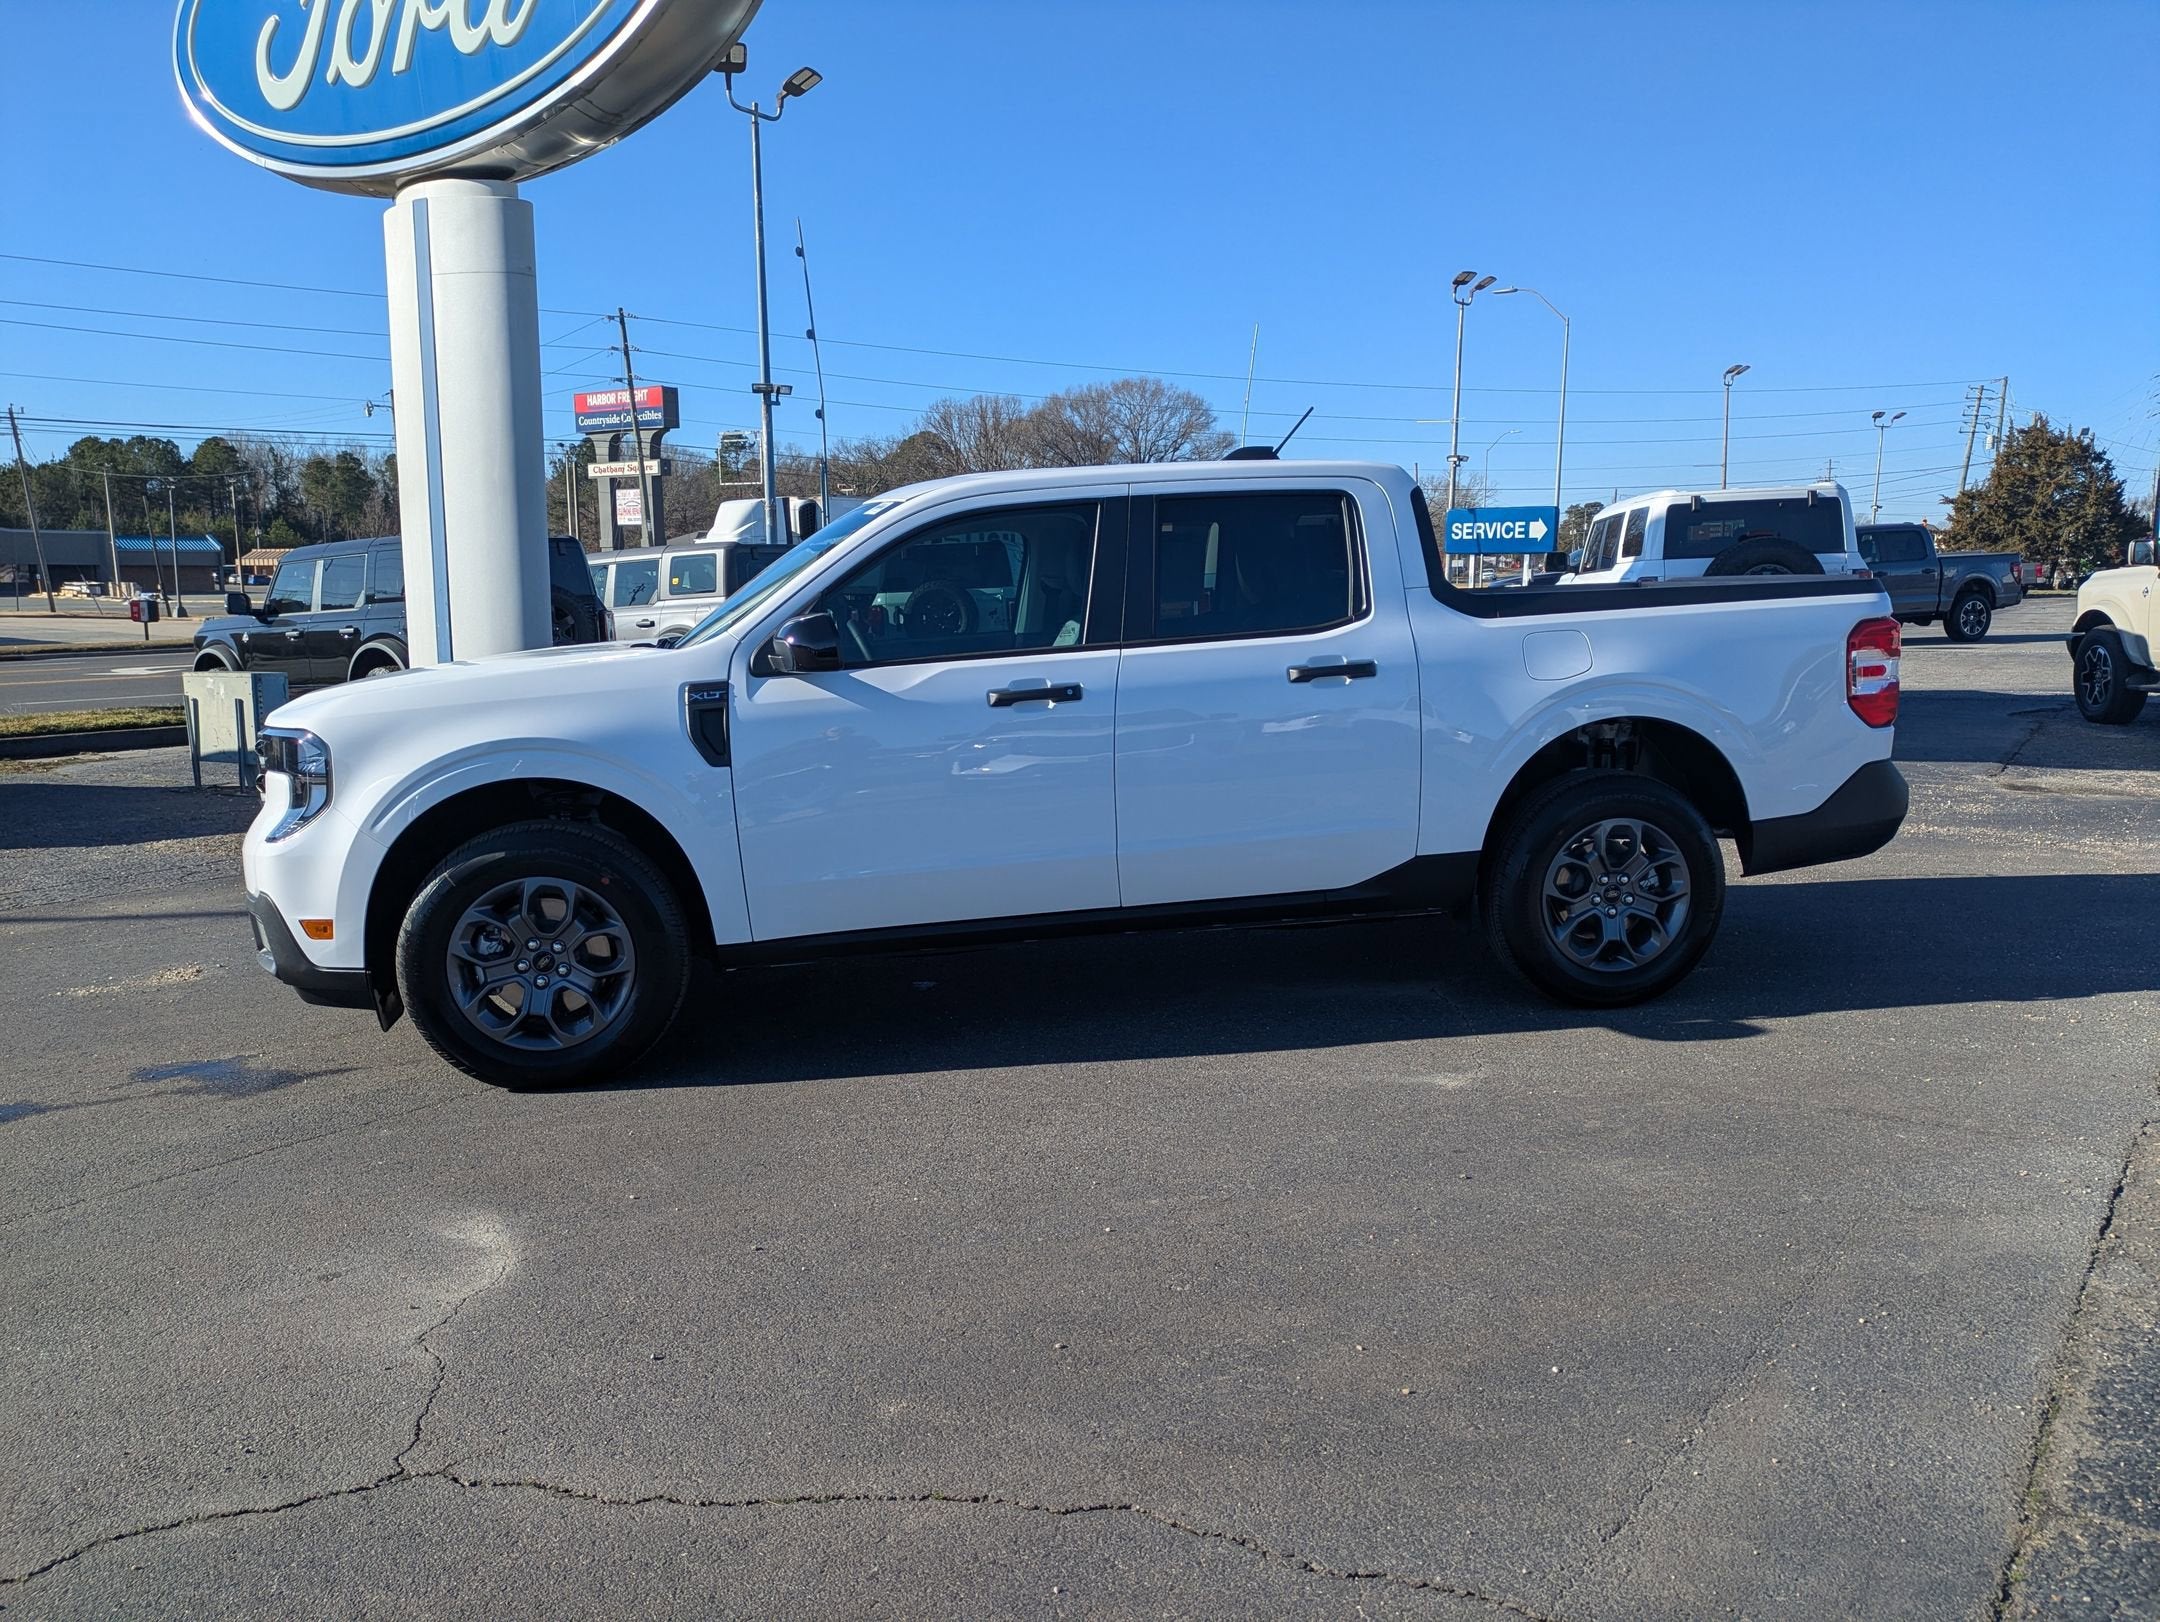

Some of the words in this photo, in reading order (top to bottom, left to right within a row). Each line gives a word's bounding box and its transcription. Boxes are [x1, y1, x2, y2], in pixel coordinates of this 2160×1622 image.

[586, 392, 616, 407] HARBOR
[617, 389, 649, 405] FREGHT
[578, 413, 620, 427] Countryside
[621, 410, 662, 423] Coctibles
[592, 465, 625, 474] Chatham
[626, 463, 653, 474] Sqre
[1451, 521, 1526, 540] SERVICE
[689, 690, 726, 701] XLT
